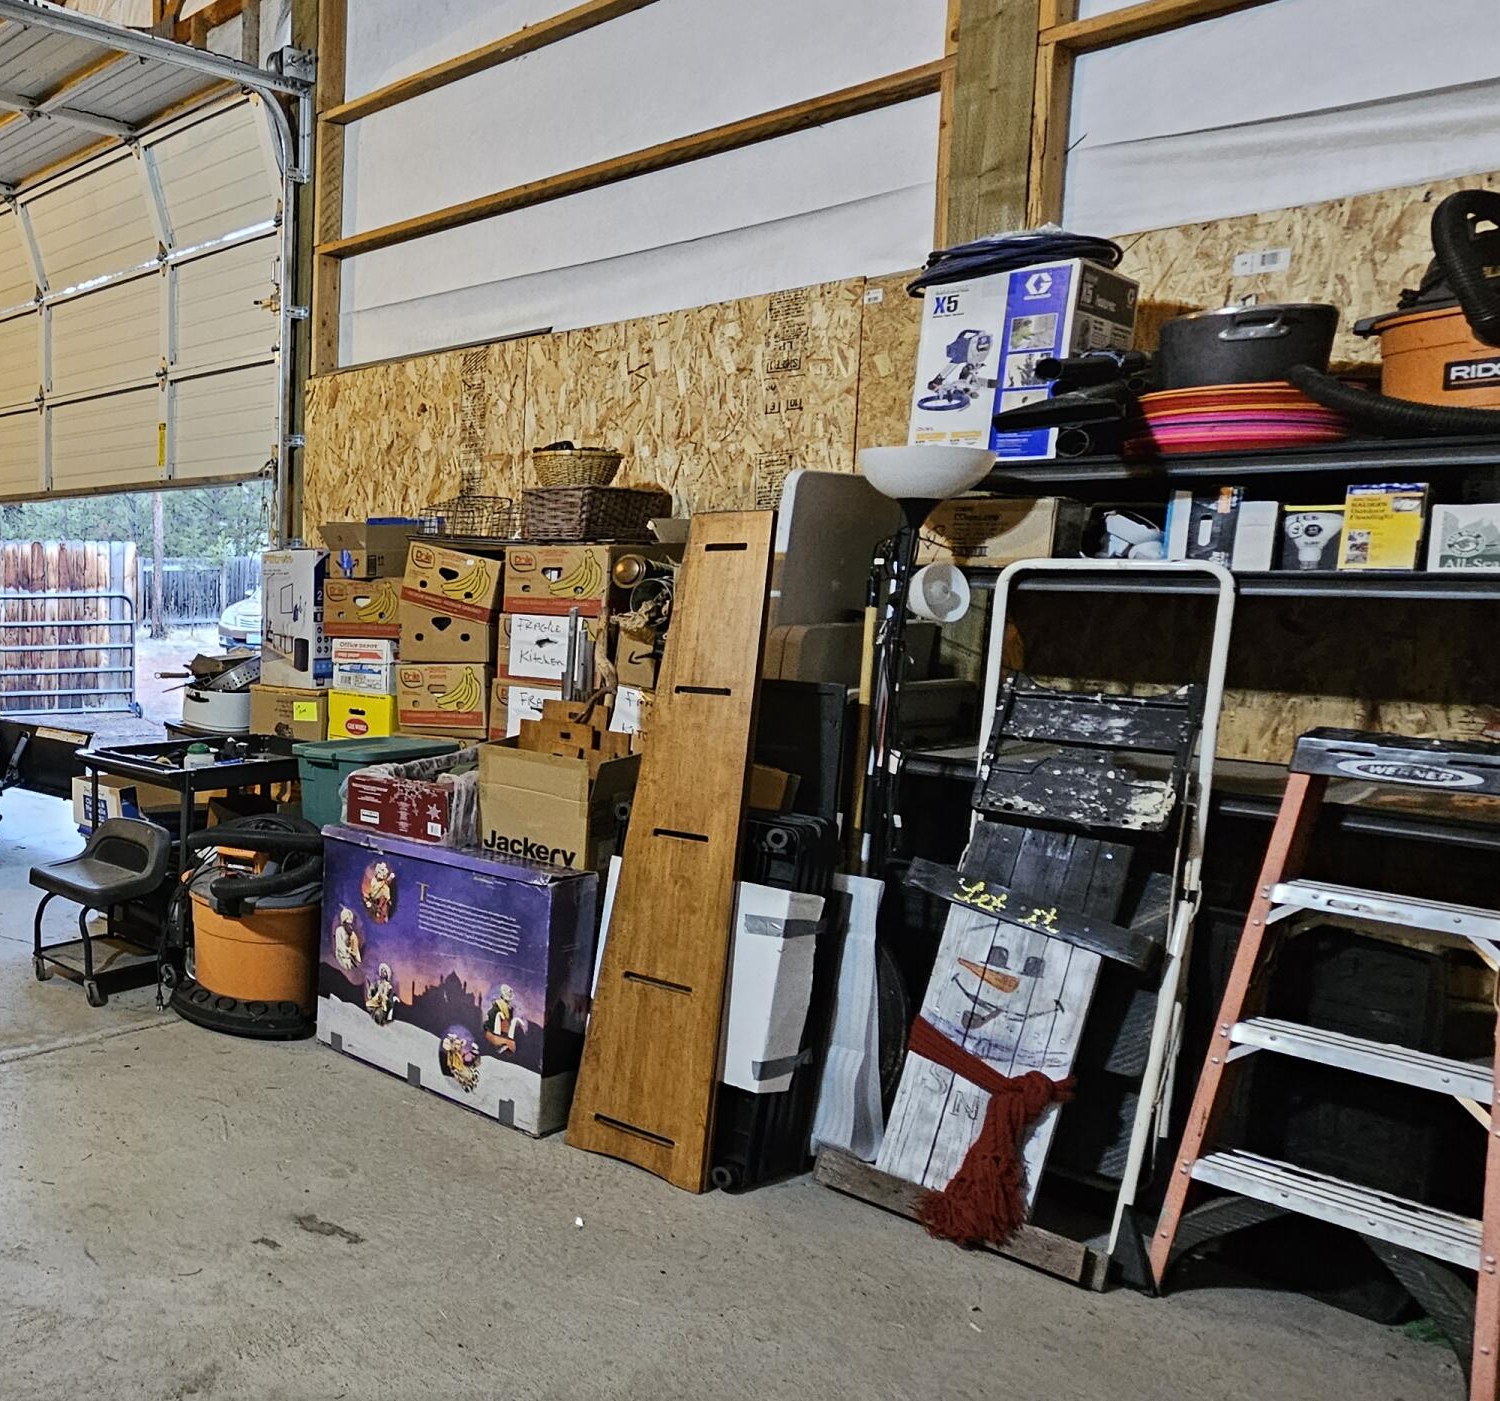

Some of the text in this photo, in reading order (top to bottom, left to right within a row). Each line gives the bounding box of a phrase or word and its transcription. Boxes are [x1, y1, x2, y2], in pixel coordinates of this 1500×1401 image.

[933, 294, 960, 315] X5
[1445, 558, 1500, 568] All-Sea
[519, 650, 565, 667] Kitchen
[484, 830, 577, 867] Jackery
